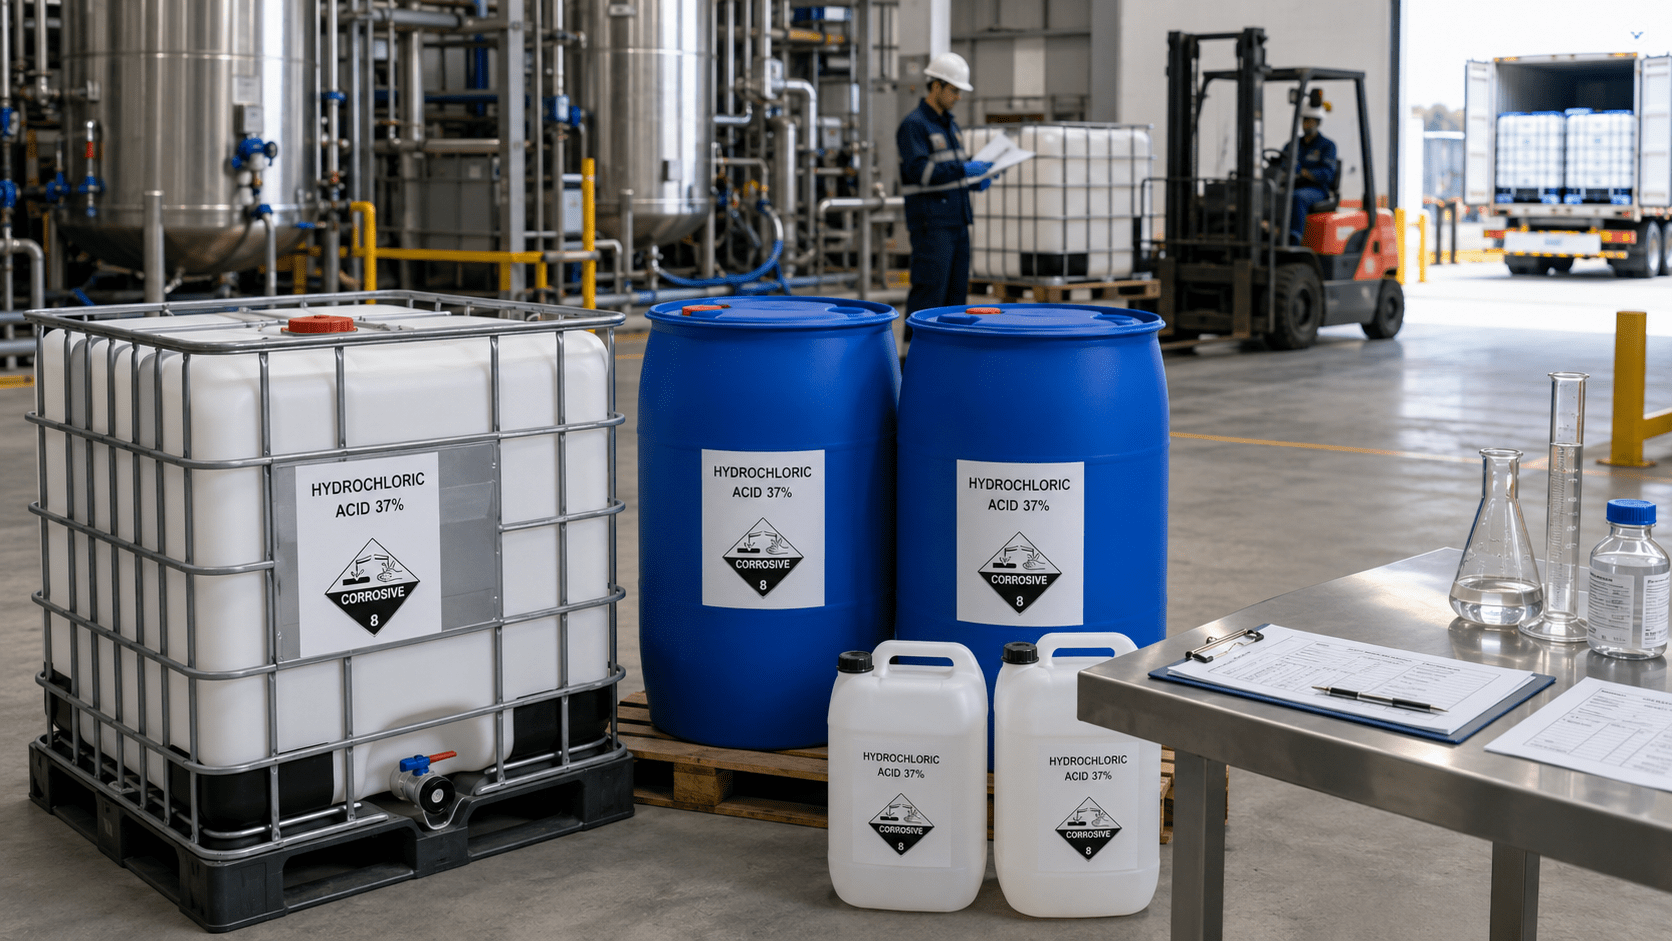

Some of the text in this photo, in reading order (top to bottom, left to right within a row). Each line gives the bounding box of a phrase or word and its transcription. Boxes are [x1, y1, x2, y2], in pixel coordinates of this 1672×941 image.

[713, 465, 812, 479] HYDROCHLORIC
[311, 472, 425, 497] HYDROCHLORIC
[968, 476, 1071, 491] HYDROCHLORIC
[732, 487, 793, 498] ACID 37%
[335, 498, 404, 518] ACID 37%
[988, 499, 1050, 511] ACID 37%
[735, 559, 790, 570] CORROSIVE
[759, 580, 767, 591] 8
[991, 574, 1048, 586] CORROSIVE
[341, 586, 405, 605] CORROSIVE
[1016, 596, 1024, 607] 8
[370, 614, 379, 627] 8
[863, 752, 940, 765] HYDROCHLORIC
[1049, 754, 1128, 766] HYDROCHLORIC
[877, 768, 925, 779] ACID 37%
[1064, 771, 1112, 781] ACID 37%
[879, 825, 923, 835] CORROSIVE
[1066, 829, 1111, 839] CORROSIVE
[897, 842, 904, 851] 8
[1085, 846, 1092, 856] 8
